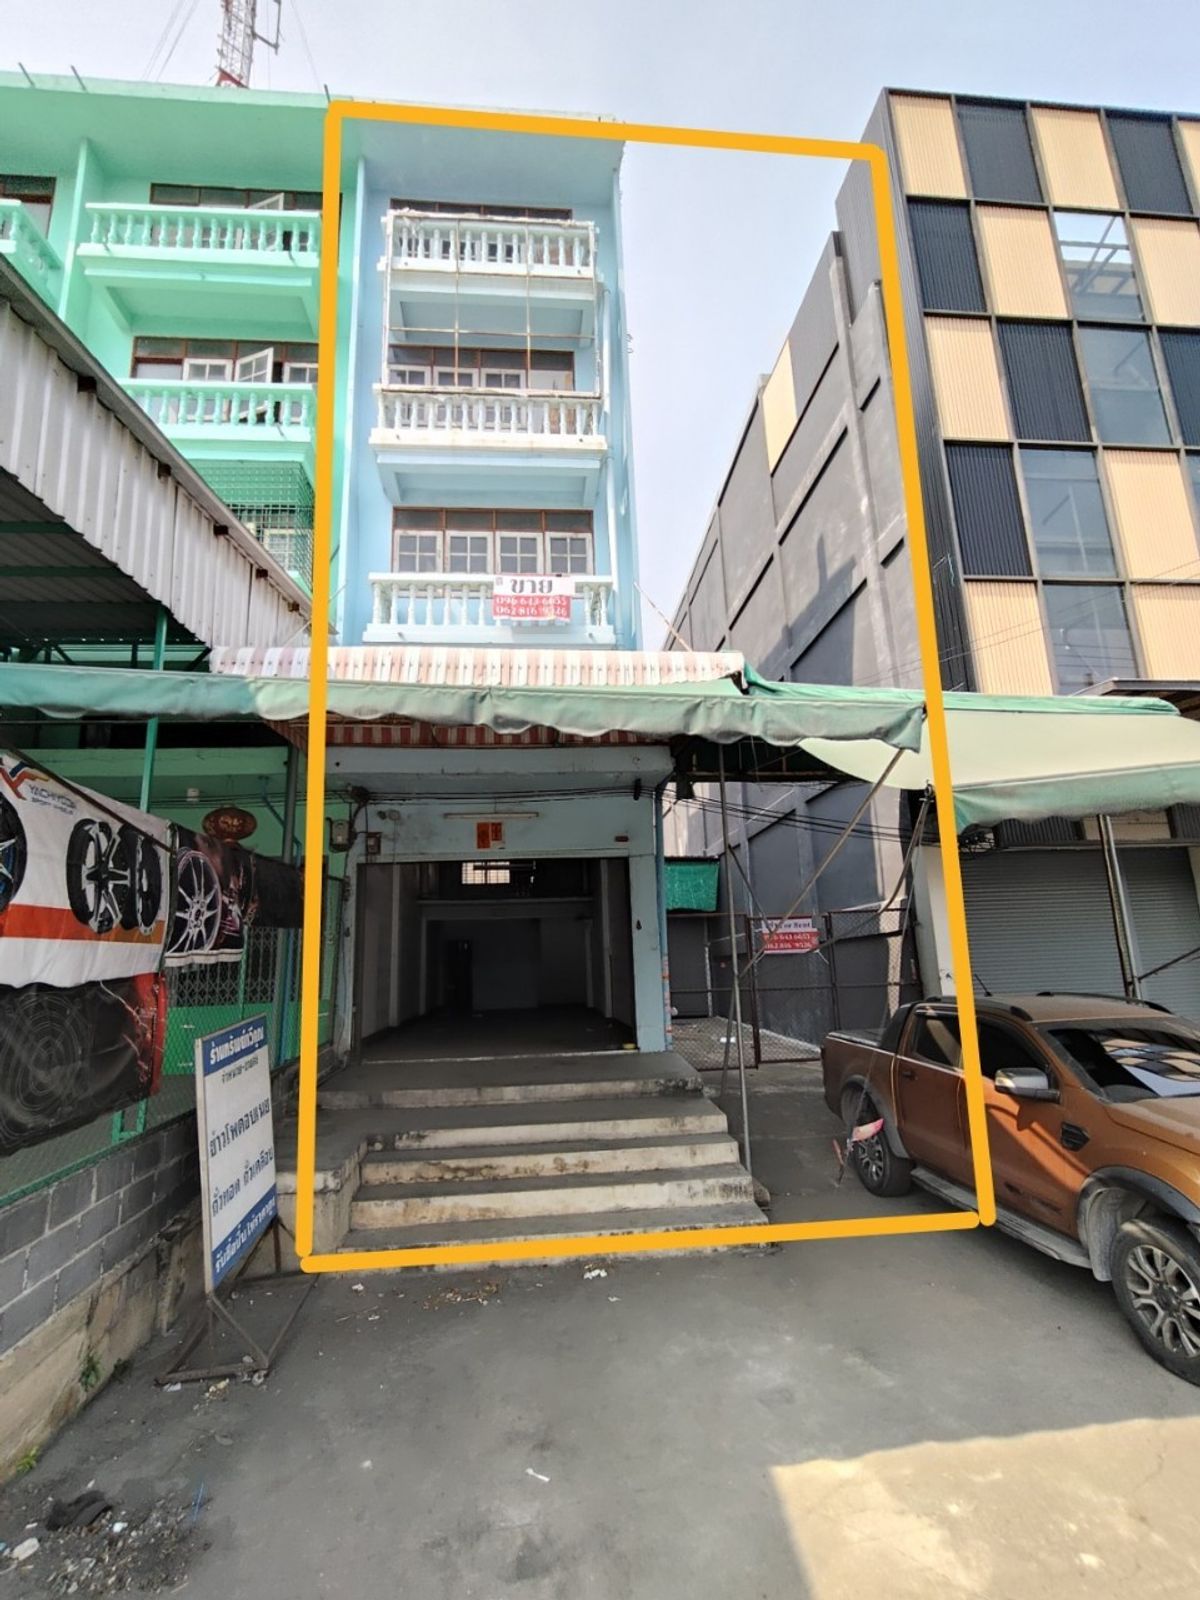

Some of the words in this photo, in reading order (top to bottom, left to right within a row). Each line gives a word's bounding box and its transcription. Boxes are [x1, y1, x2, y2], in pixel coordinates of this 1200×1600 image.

[510, 578, 553, 594] ขาย
[210, 1097, 270, 1157] ข้าวโพดอบเนย
[212, 1177, 241, 1217] ถั่วทอด
